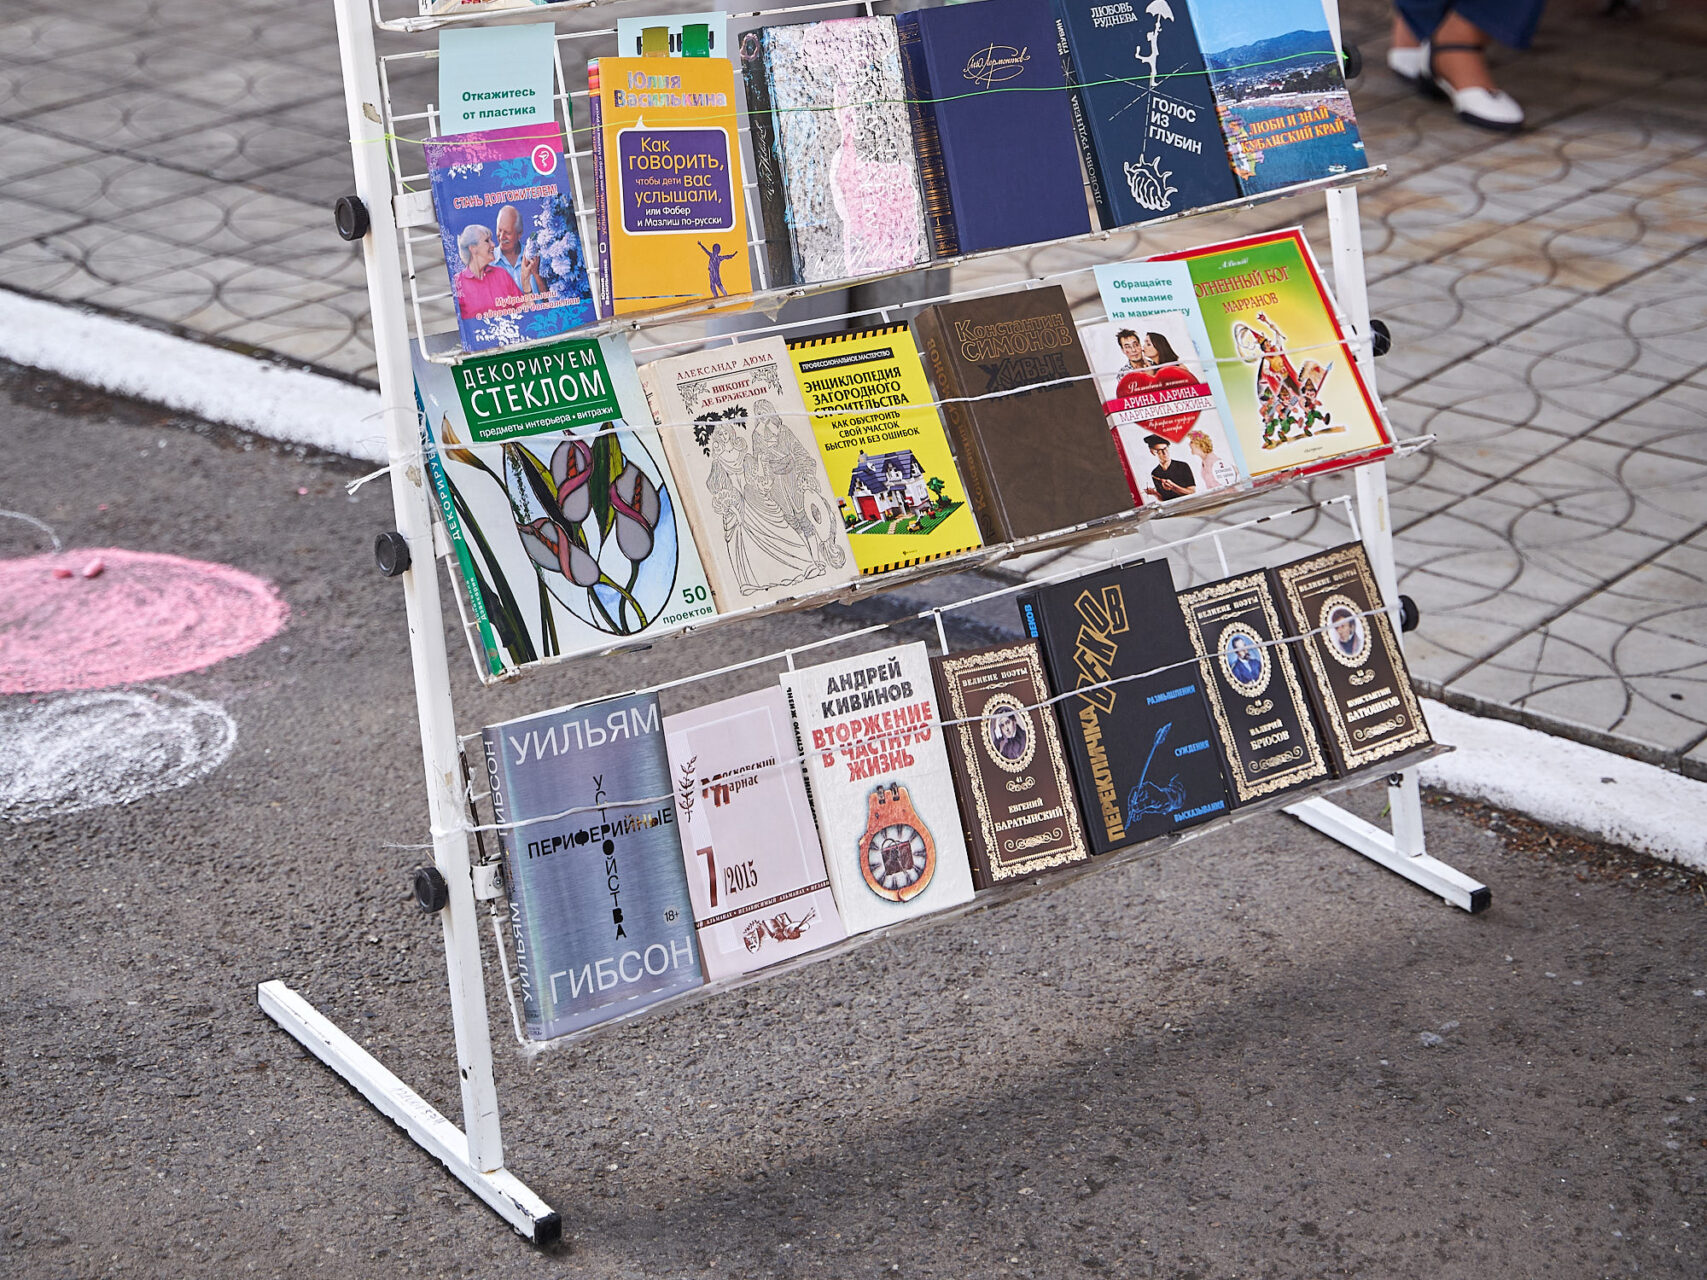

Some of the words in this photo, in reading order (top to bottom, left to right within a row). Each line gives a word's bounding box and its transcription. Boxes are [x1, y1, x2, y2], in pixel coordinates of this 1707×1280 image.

[1090, 2, 1133, 19] ЛЮБОВЬ
[1093, 12, 1138, 28] РУДНЕВА
[628, 72, 681, 89] Юлия
[462, 89, 536, 101] Откажитесь
[614, 88, 727, 108] Василькина
[462, 111, 476, 119] от
[479, 105, 536, 118] пластика
[1151, 113, 1169, 128] ИЗ
[1152, 97, 1197, 123] ГОЛОС
[1249, 119, 1286, 136] ЛЮБИ
[1287, 116, 1296, 128] И
[1297, 104, 1330, 123] ЗНАЙ
[1071, 95, 1091, 150] РУДНЕВА
[641, 138, 670, 153] Как
[1149, 126, 1202, 155] ГЛУБИН
[1240, 123, 1314, 154] КУБАНСКИЙ
[1315, 117, 1346, 138] КРАЙ
[629, 150, 724, 172] говорить,
[635, 176, 661, 186] чтобы
[662, 175, 681, 186] дети
[684, 173, 711, 188] вас
[1086, 152, 1104, 205] ЛЮБОВЬ
[453, 197, 483, 209] СТАНЬ
[484, 184, 558, 207] ДОЛГОЖИТЕЛЕМ!
[635, 188, 722, 208] услышали,
[645, 207, 660, 215] или
[662, 206, 691, 217] Фабер
[645, 216, 679, 227] Мазлиш
[682, 216, 722, 227] по-русски
[1113, 277, 1172, 290] Обращайте
[1194, 270, 1265, 298] ОГНЕННЫЙ
[1267, 266, 1289, 283] БОГ
[1120, 294, 1173, 304] внимание
[1222, 292, 1279, 314] МАРРАНОВ
[954, 313, 1064, 342] Константин
[961, 327, 1073, 362] СИМОНОВ
[464, 348, 598, 390] ДЕКОРИРУЕМ
[676, 360, 738, 380] АЛЕКСАНДР
[743, 353, 774, 369] ДЮМА
[711, 378, 751, 394] ВИКОНТ
[804, 366, 902, 393] ЭНЦИКЛОПЕДИЯ
[470, 369, 607, 418] СТЕКЛОМ
[701, 396, 714, 409] ДЕ
[715, 386, 768, 406] БРАЖЕЛОН
[812, 380, 901, 405] ЗАГОРОДНОГО
[1123, 393, 1158, 410] АРИНА
[1159, 386, 1199, 403] ЛАРИНА
[814, 393, 910, 419] СТРОИТЕЛЬСТВА
[1119, 404, 1175, 423] МАРГАРИТА
[1174, 397, 1212, 412] ЮЖИНА
[479, 420, 525, 438] предметы
[525, 413, 572, 429] интерьера
[577, 406, 614, 420] витражи
[831, 418, 848, 430] КАК
[849, 410, 900, 427] ОБУСТРОИТЬ
[839, 426, 862, 438] СВОЙ
[862, 420, 900, 434] УЧАСТОК
[825, 438, 858, 451] БЫСТРО
[858, 436, 866, 445] И
[866, 433, 881, 444] БЕЗ
[882, 426, 920, 441] ОШИБОК
[682, 584, 708, 605] 50
[663, 605, 714, 625] проектов
[826, 656, 903, 696] АНДРЕЙ
[962, 675, 998, 687] ВЕЛИКИЕ
[1001, 667, 1028, 680] ПОЭТЫ
[821, 685, 914, 719] КИВИНОВ
[1146, 685, 1196, 705] РАЗМЫШЛЕНИЯ
[1346, 687, 1392, 707] КОНСТАНТИН
[1346, 696, 1401, 723] БАТЮШКОВ
[509, 703, 661, 767] УИЛЬЯМ
[812, 701, 933, 750] ВТОРЖЕНИЕ
[1249, 719, 1283, 736] ВАЛЕРИЙ
[1174, 740, 1210, 756] СУЖДЕНИЯ
[1250, 730, 1290, 752] БРЮСОВ
[847, 749, 915, 782] ЖИЗНЬ
[1008, 797, 1044, 813] ЕВГЕНИЙ
[1174, 800, 1225, 823] ВЫСКАЗЫВАНИЯ
[995, 806, 1064, 832] БАРАТЫНСКИЙ
[528, 808, 673, 859] ПЕРИФЕРИЙНЫЕ
[663, 909, 680, 923] 18+
[549, 935, 695, 1004] ГИБСОН
